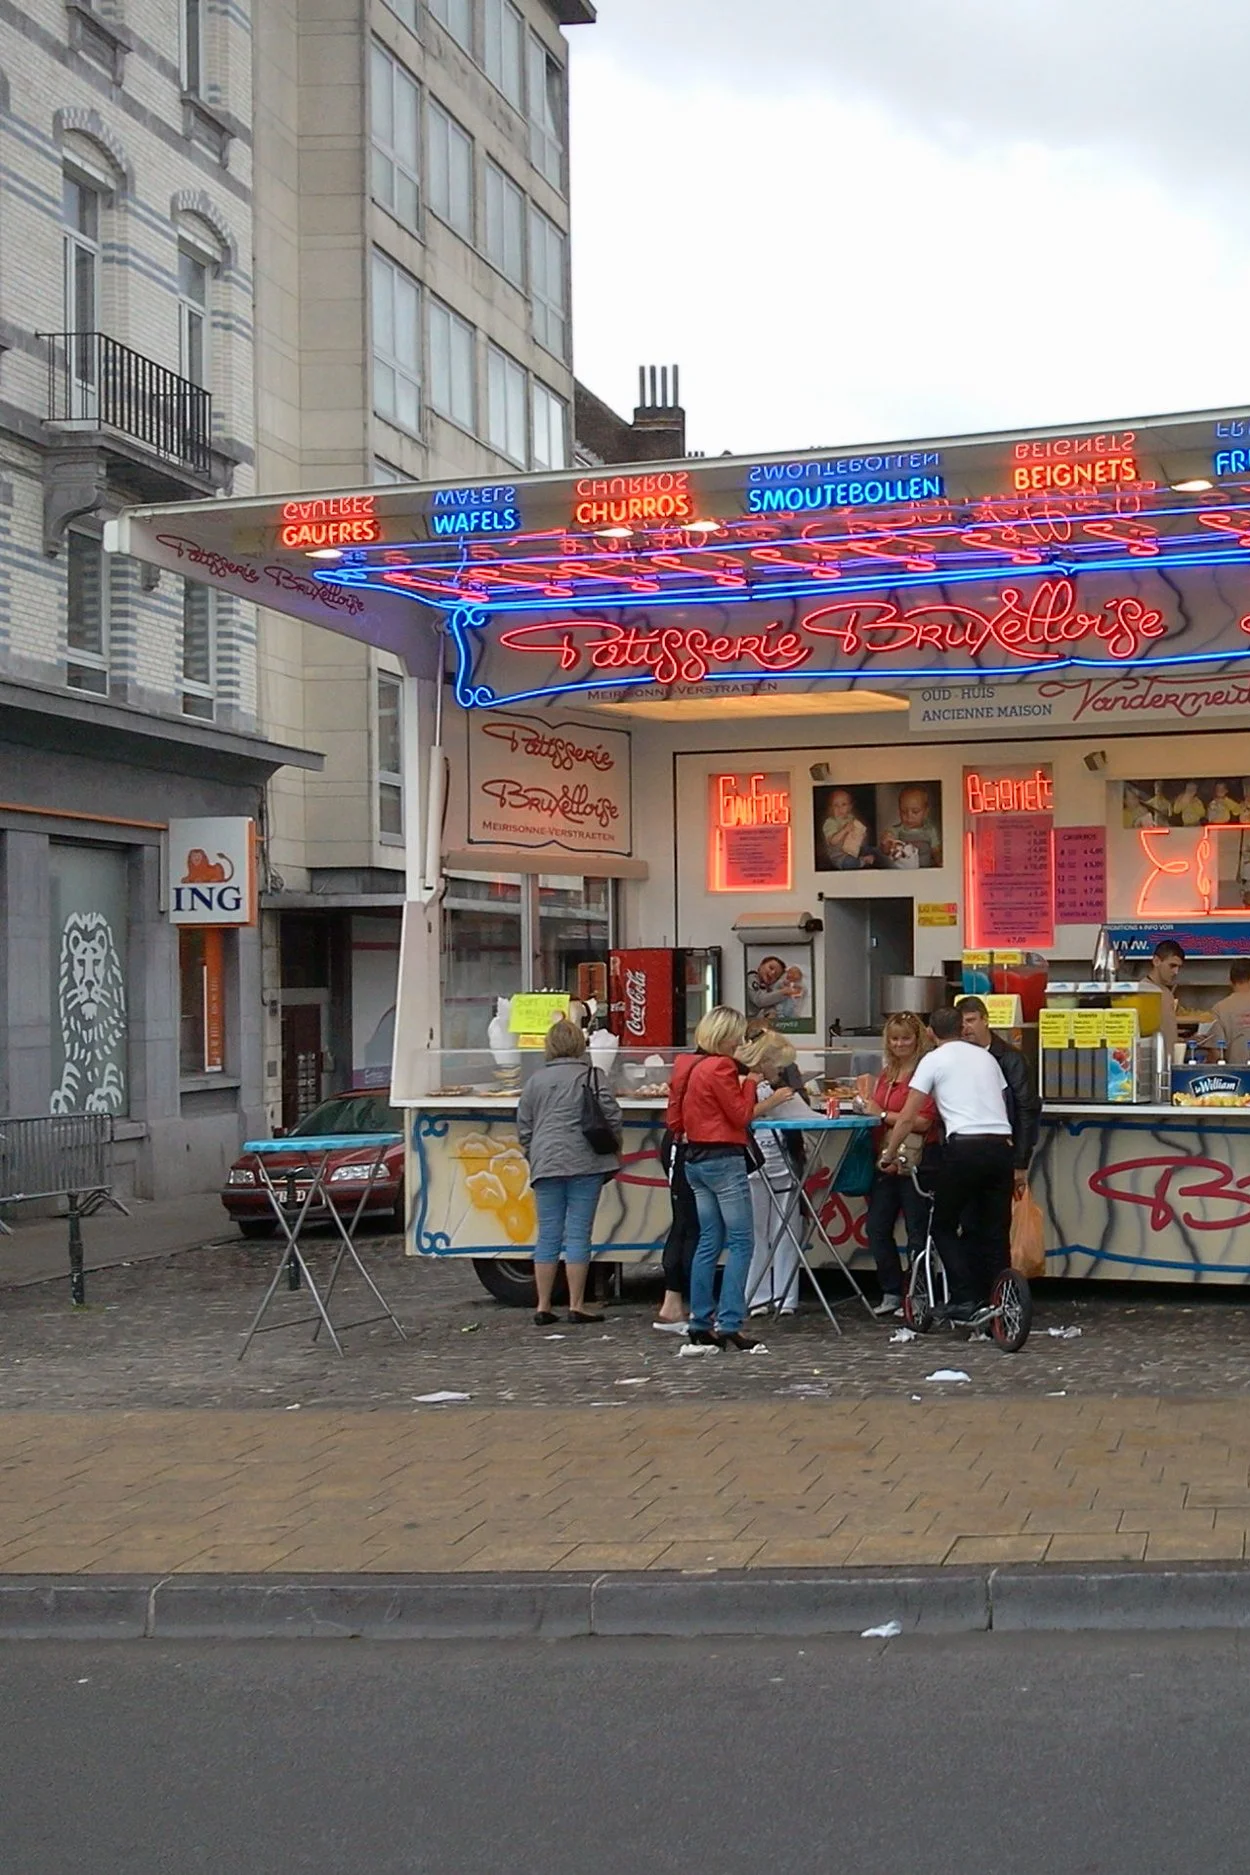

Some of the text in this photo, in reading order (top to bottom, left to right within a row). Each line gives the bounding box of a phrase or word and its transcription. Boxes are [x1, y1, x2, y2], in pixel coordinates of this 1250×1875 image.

[1014, 458, 1137, 490] BEIGNETS
[749, 476, 940, 512] SMOUTEBOLLEN
[433, 508, 516, 533] WAFELS
[576, 494, 689, 524] CHURROS
[282, 519, 376, 546] GAUFRES
[921, 686, 995, 702] OUD HUIS
[921, 704, 1053, 722] ANCIENNE MAISON
[173, 886, 243, 912] ING
[1201, 1076, 1236, 1092] William
